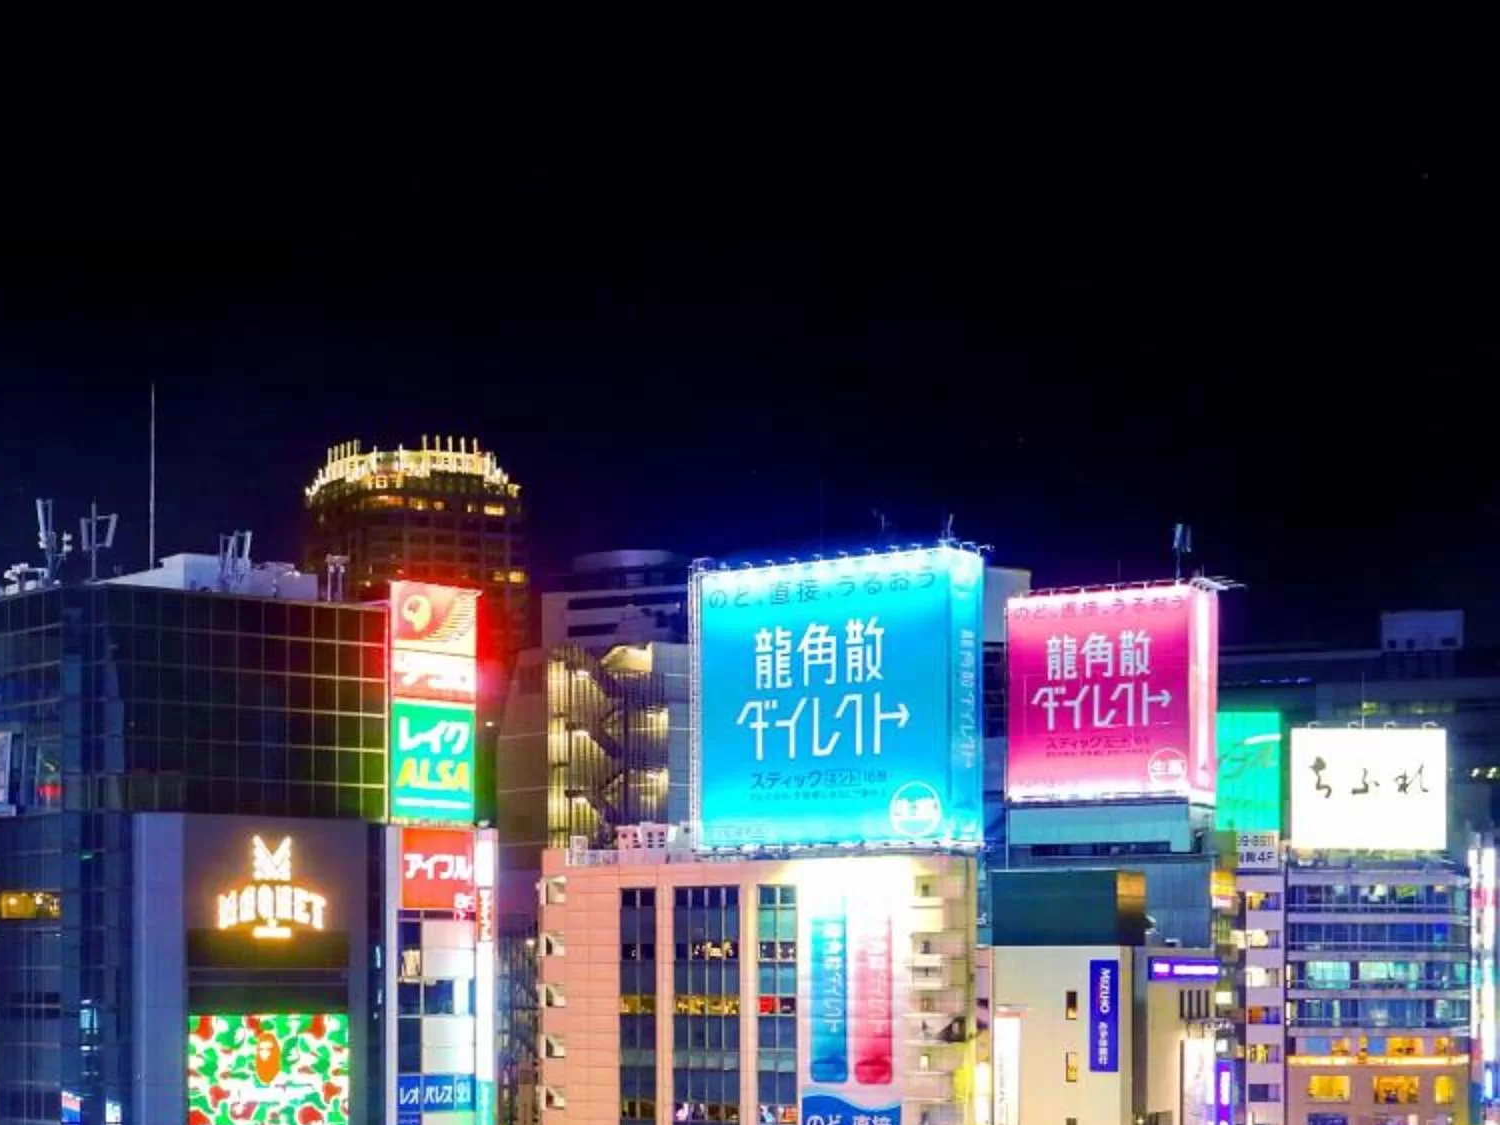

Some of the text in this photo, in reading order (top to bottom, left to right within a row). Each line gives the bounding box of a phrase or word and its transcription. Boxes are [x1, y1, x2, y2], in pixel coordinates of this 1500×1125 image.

[755, 616, 885, 690] 龍角散
[1046, 630, 1152, 681] 龍角散
[736, 692, 911, 761] ダイレクト
[1031, 681, 1173, 731] ダイレクト
[399, 716, 470, 755] レイク
[397, 757, 470, 790] ALSA
[1309, 756, 1429, 799] ちふれ
[404, 854, 473, 881] アイフル
[217, 884, 327, 930] MAGNET
[1100, 967, 1111, 1014] MIZUHO
